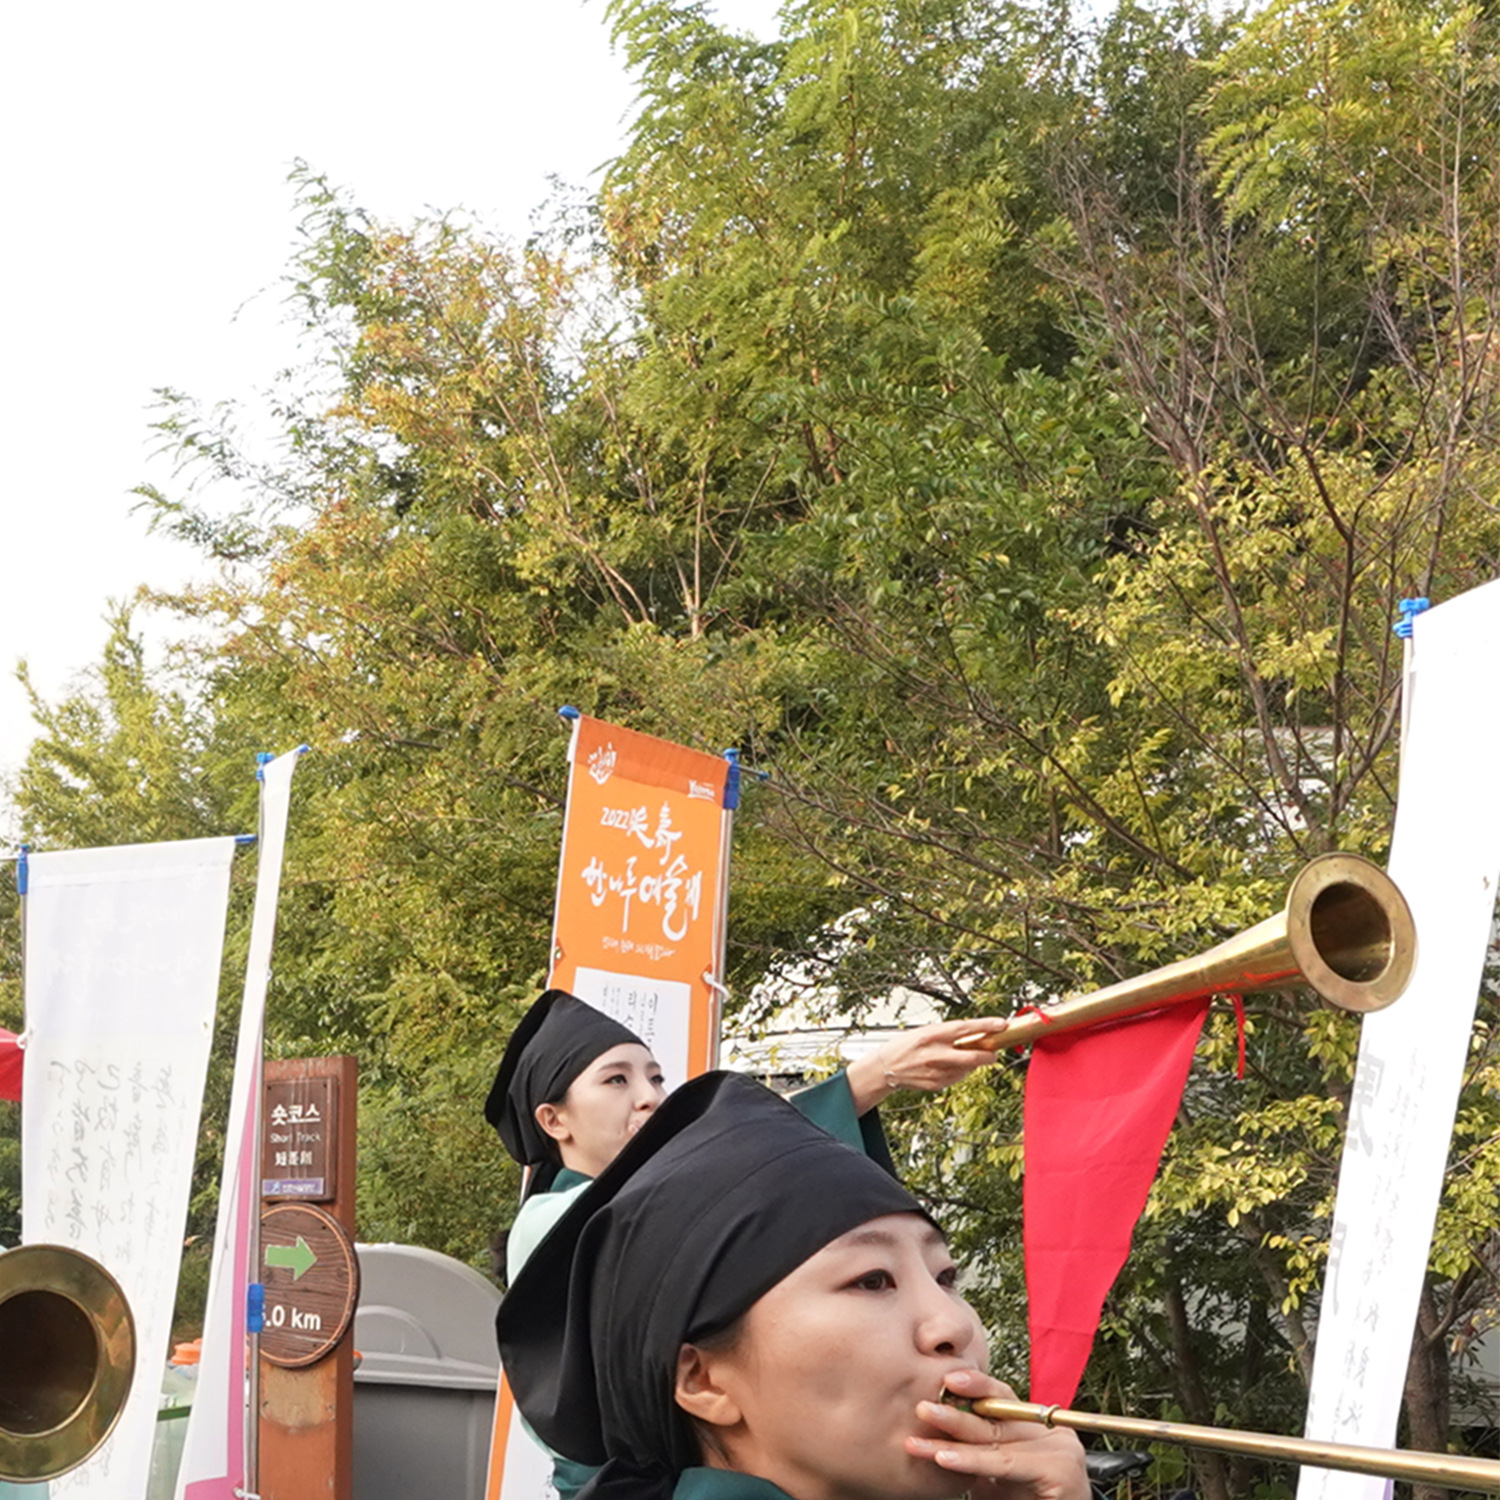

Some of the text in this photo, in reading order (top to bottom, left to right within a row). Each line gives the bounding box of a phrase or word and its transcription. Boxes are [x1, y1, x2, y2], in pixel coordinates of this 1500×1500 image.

[600, 806, 629, 830] 2022
[271, 1103, 321, 1126] 숏코스
[262, 1303, 321, 1330] .0 km
